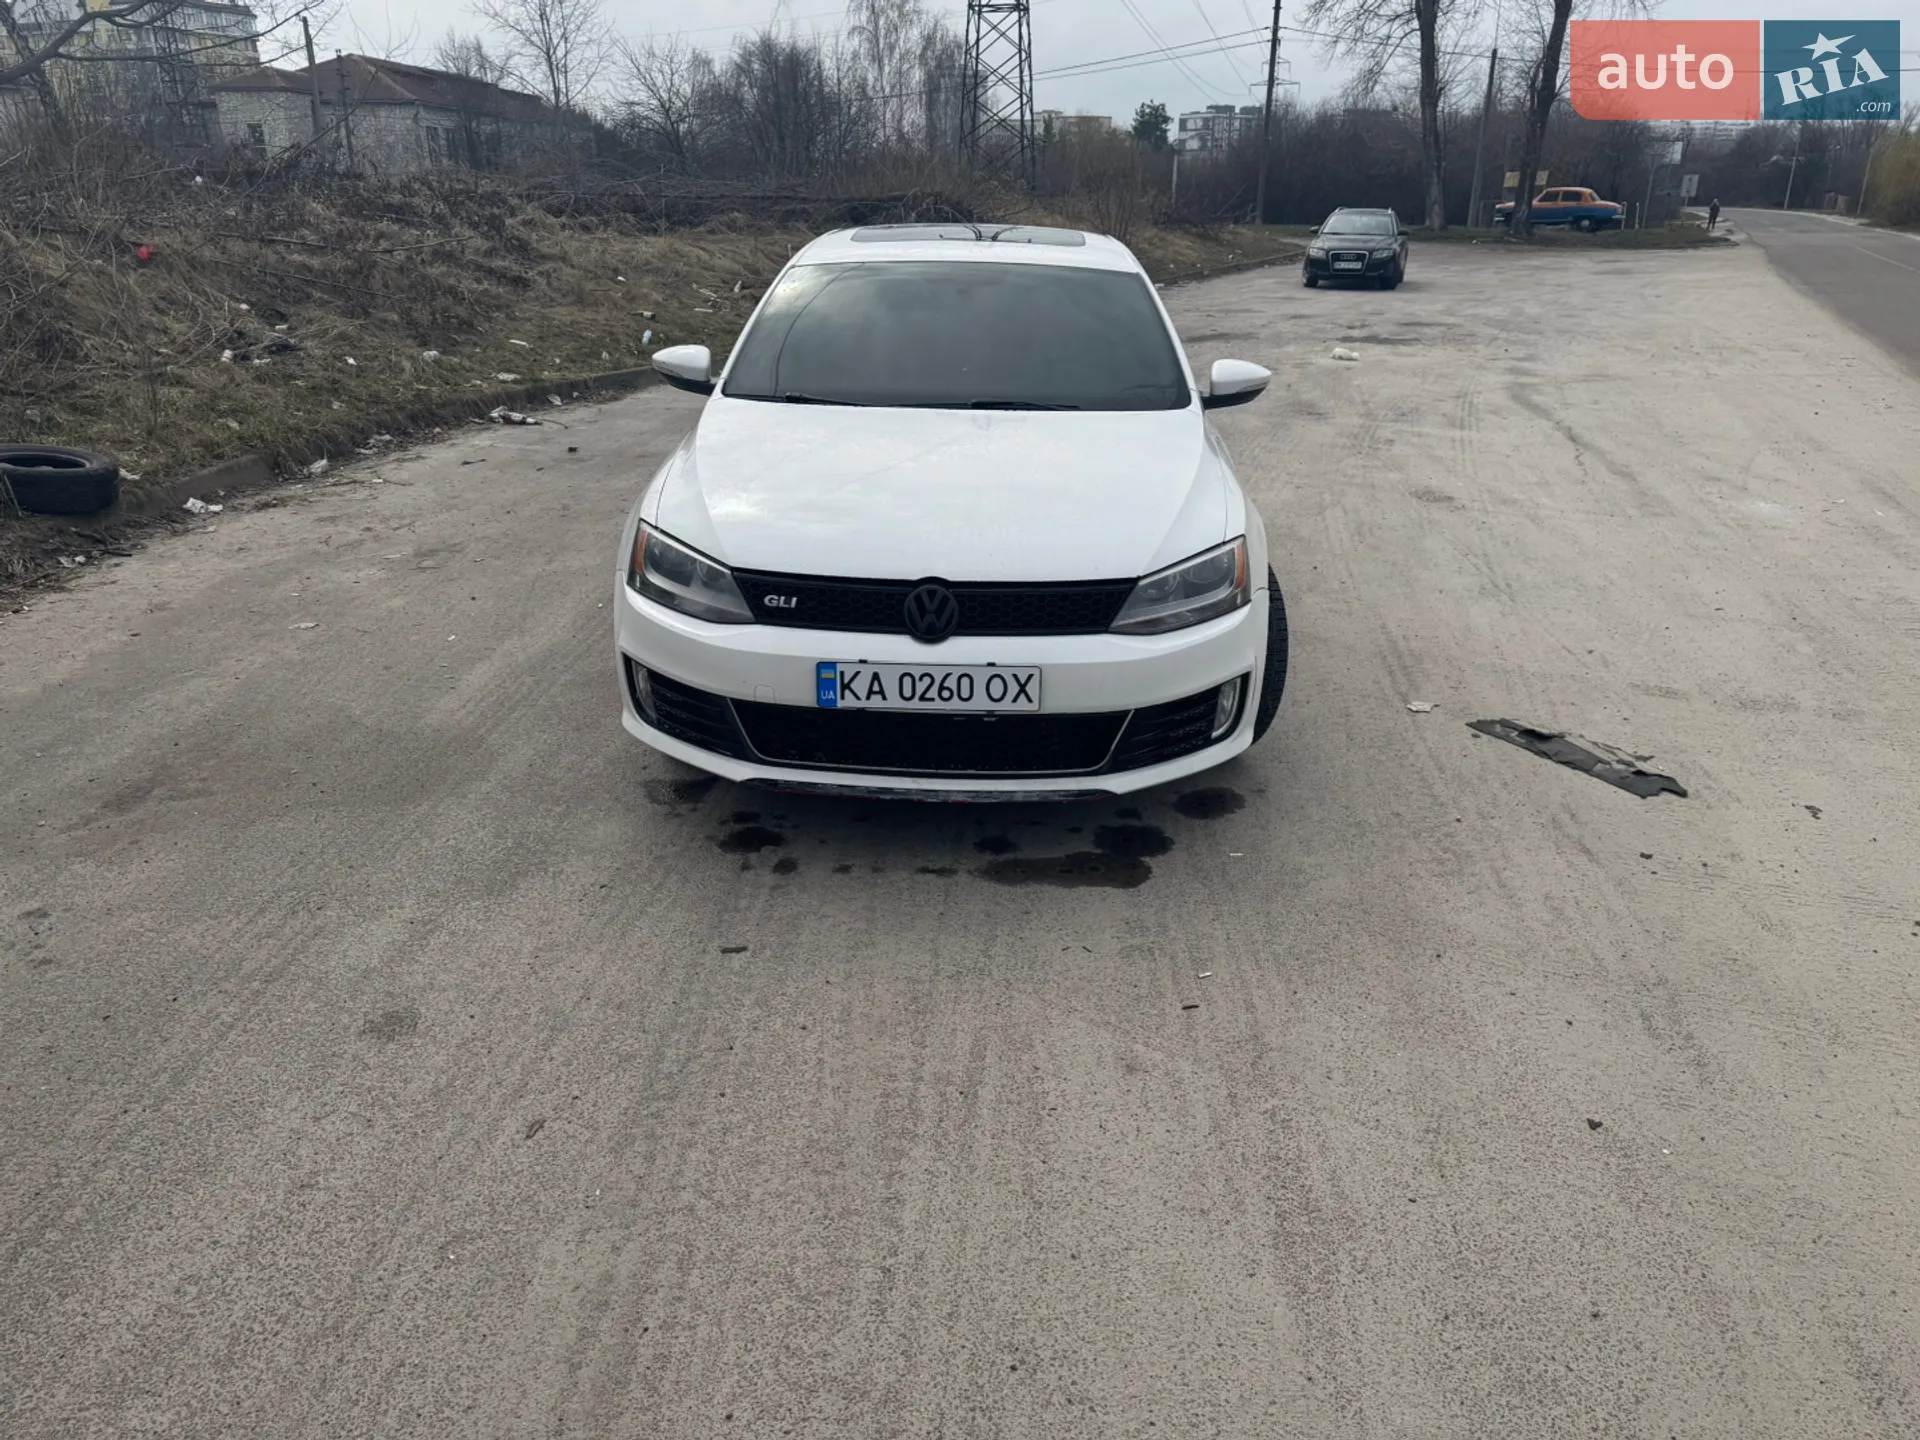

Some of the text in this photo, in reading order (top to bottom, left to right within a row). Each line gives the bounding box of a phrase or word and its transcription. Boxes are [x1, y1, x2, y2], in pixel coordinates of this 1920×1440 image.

[763, 594, 798, 609] GLI
[820, 689, 836, 700] UA
[839, 670, 1035, 704] KA 0260 OX
